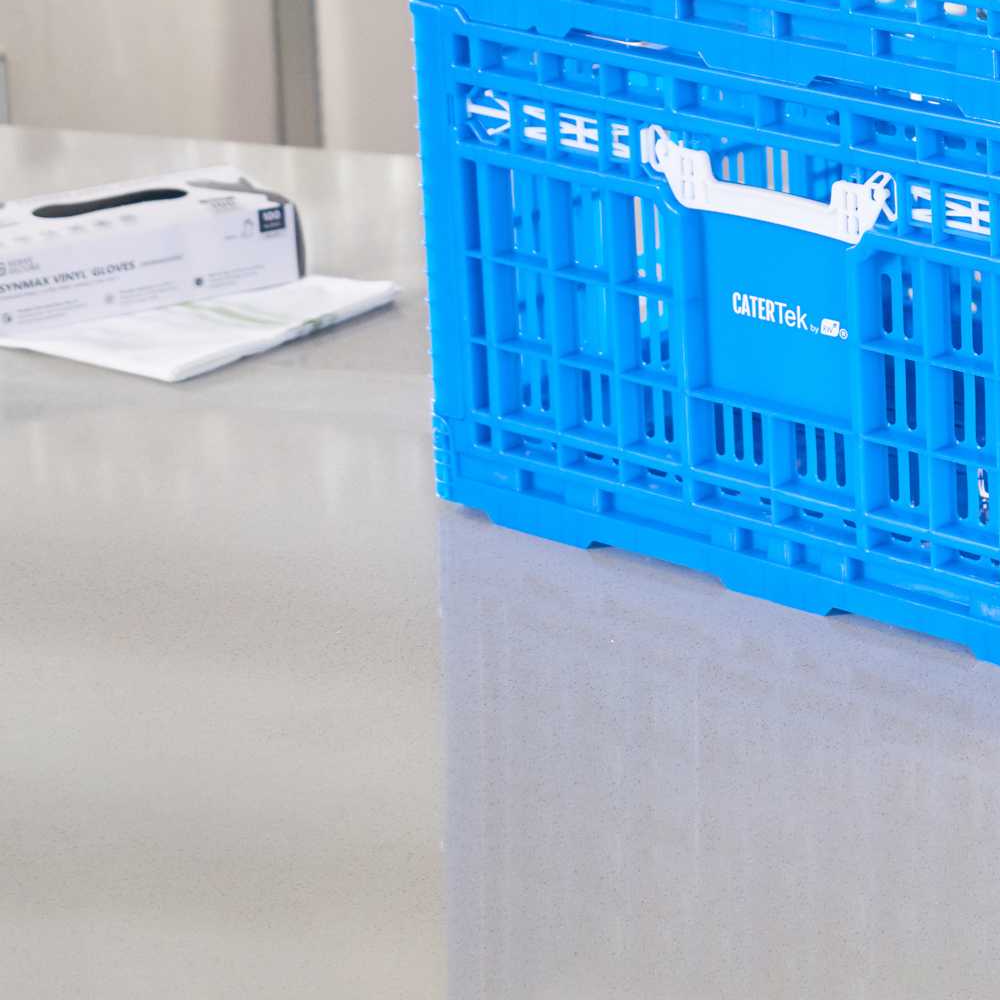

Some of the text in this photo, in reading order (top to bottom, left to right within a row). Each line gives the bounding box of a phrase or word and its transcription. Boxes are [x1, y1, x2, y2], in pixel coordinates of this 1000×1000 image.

[53, 269, 86, 284] VINYL
[91, 261, 136, 277] GLOVES
[732, 291, 808, 330] CATERTek
